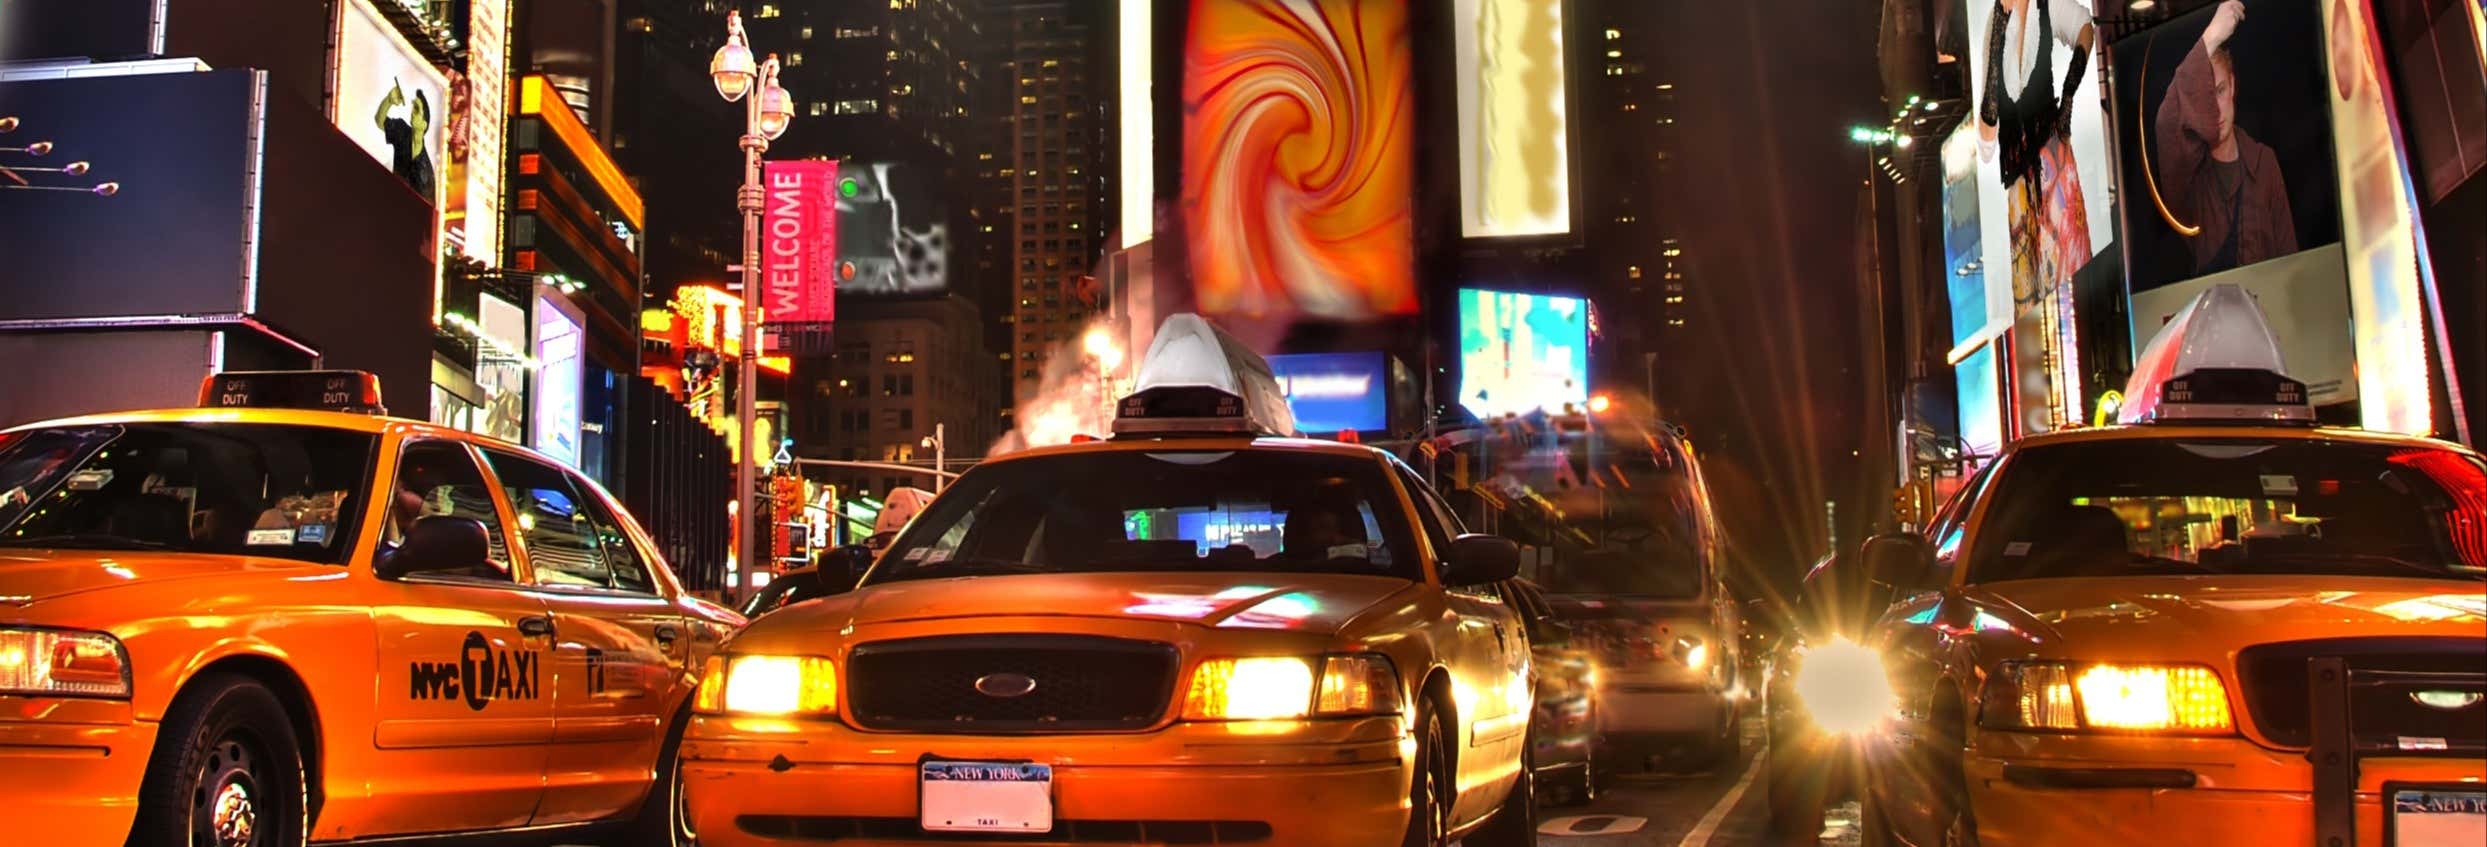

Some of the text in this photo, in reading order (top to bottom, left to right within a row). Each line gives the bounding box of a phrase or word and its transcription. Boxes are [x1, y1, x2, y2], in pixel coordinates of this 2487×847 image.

[771, 172, 802, 318] WELCOME
[227, 380, 246, 392] OFF
[327, 379, 345, 391] OFF
[222, 393, 248, 406] DUTY
[323, 392, 350, 405] DUTY
[2169, 390, 2193, 402] DUTY
[2276, 392, 2301, 403] DUTY
[1124, 407, 1146, 417] DUTY
[1216, 405, 1238, 416] DUTY
[410, 662, 460, 699] NYC
[464, 644, 538, 703] TAXI
[953, 766, 1021, 781] NEW YORK
[2431, 798, 2466, 812] NEW
[977, 818, 999, 826] TAXI
